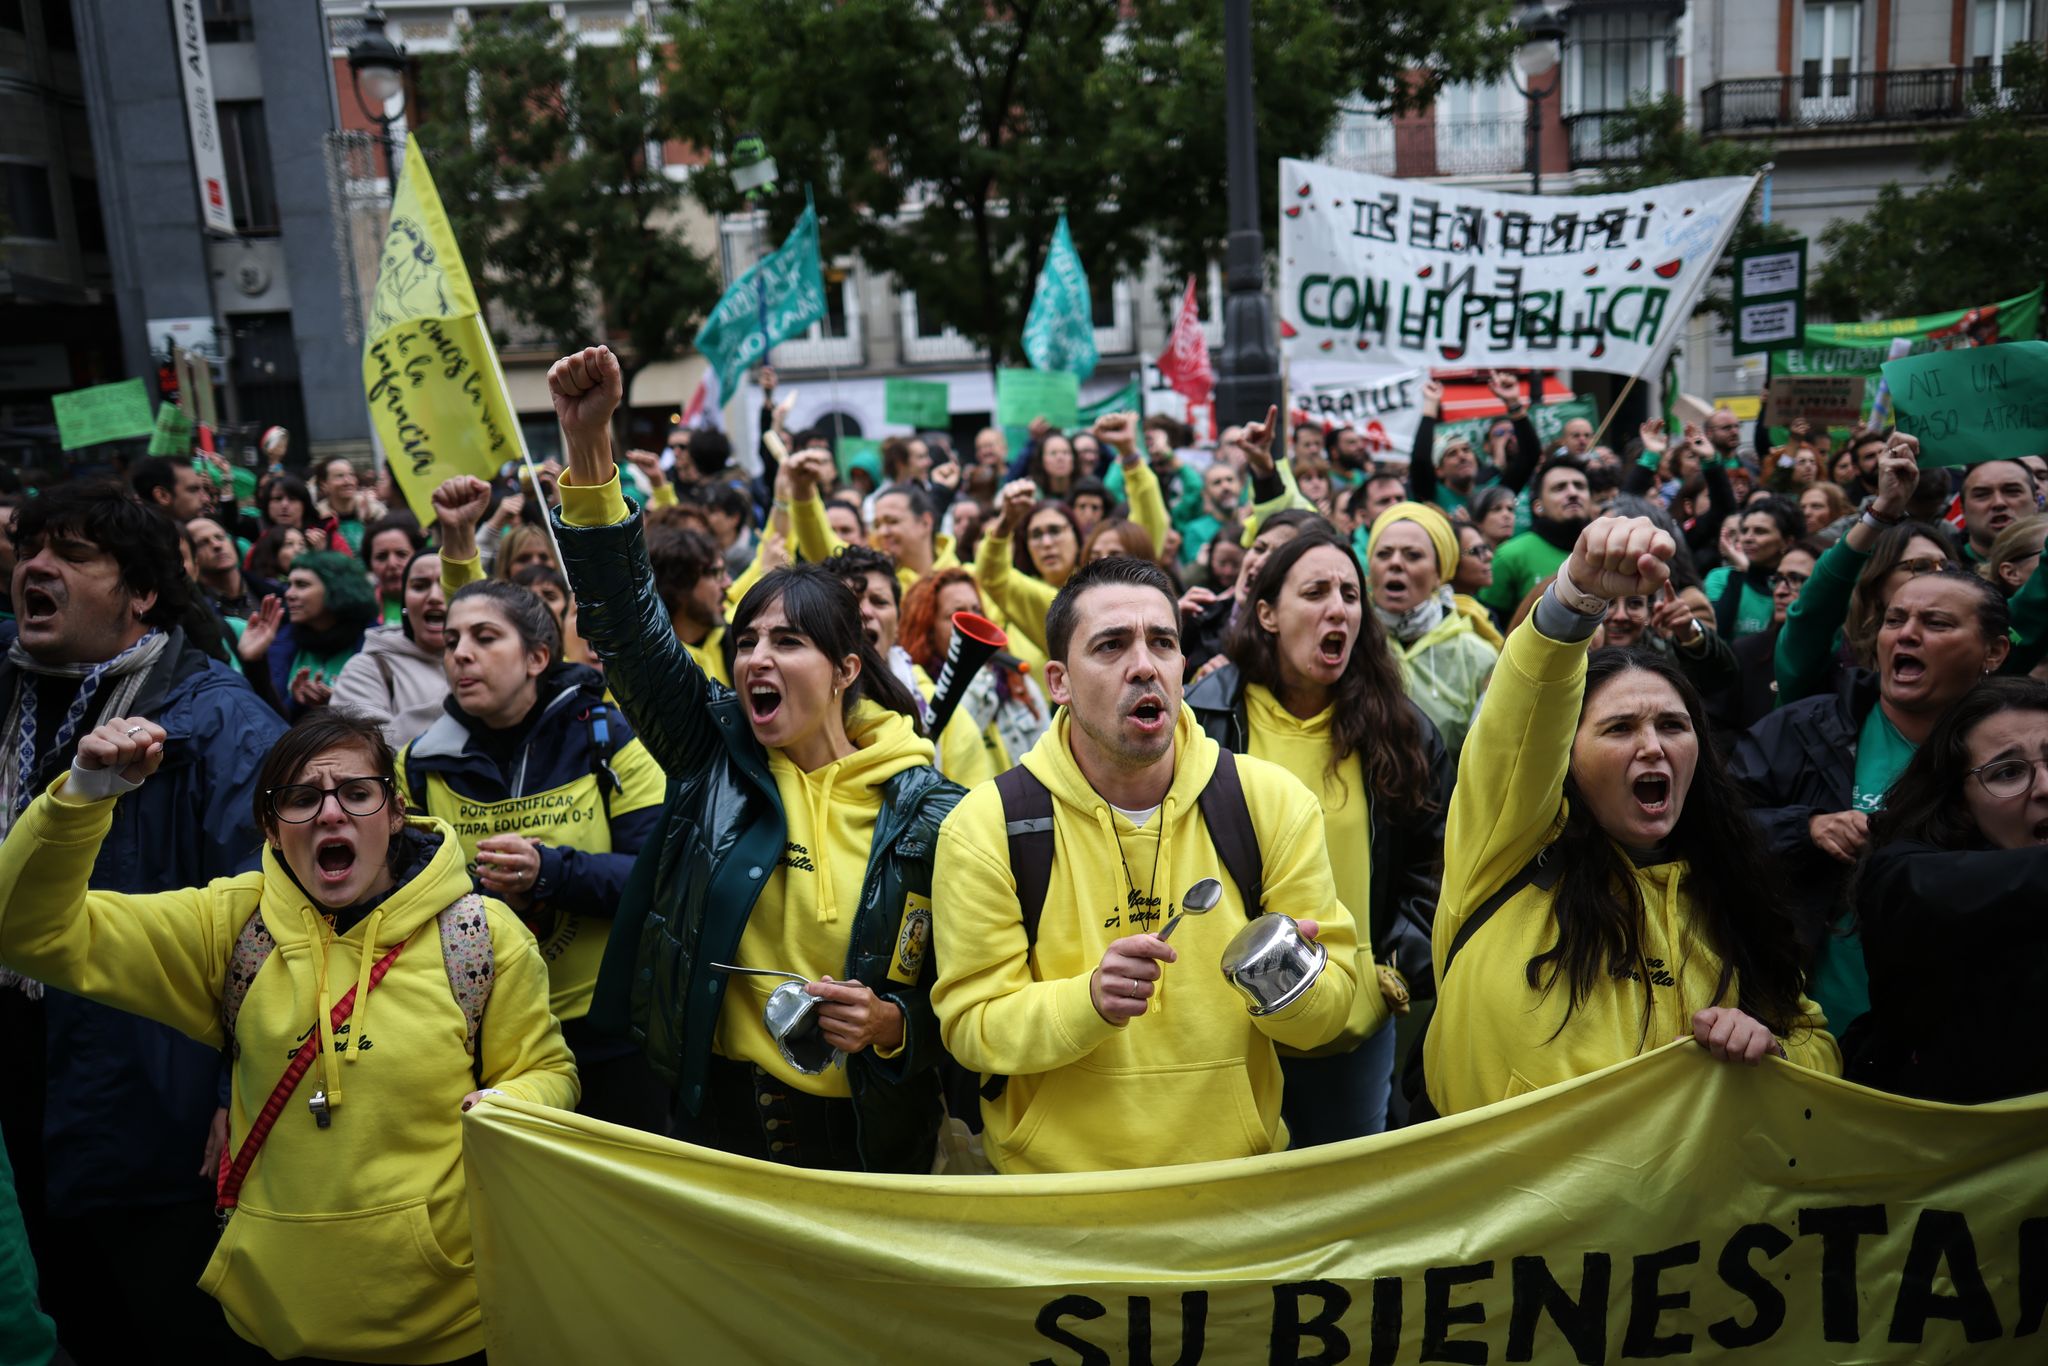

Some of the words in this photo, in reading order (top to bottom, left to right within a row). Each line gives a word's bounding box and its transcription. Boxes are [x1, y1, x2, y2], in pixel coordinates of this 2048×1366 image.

[183, 0, 204, 78] Alca
[194, 85, 216, 152] Sala
[1299, 274, 1389, 333] CON
[1400, 285, 1445, 338] LA
[404, 355, 433, 388] la
[1908, 368, 1948, 400] NI
[1971, 356, 2009, 393] UN
[368, 339, 435, 477] infancia
[1904, 408, 1959, 441] PASO
[460, 804, 488, 818] POR
[491, 795, 574, 815] DIGNIFICAR
[494, 812, 568, 833] EDUCATIVA
[571, 808, 594, 823] 0-3
[1127, 889, 1161, 909] Mare
[1029, 1290, 1208, 1366] SU
